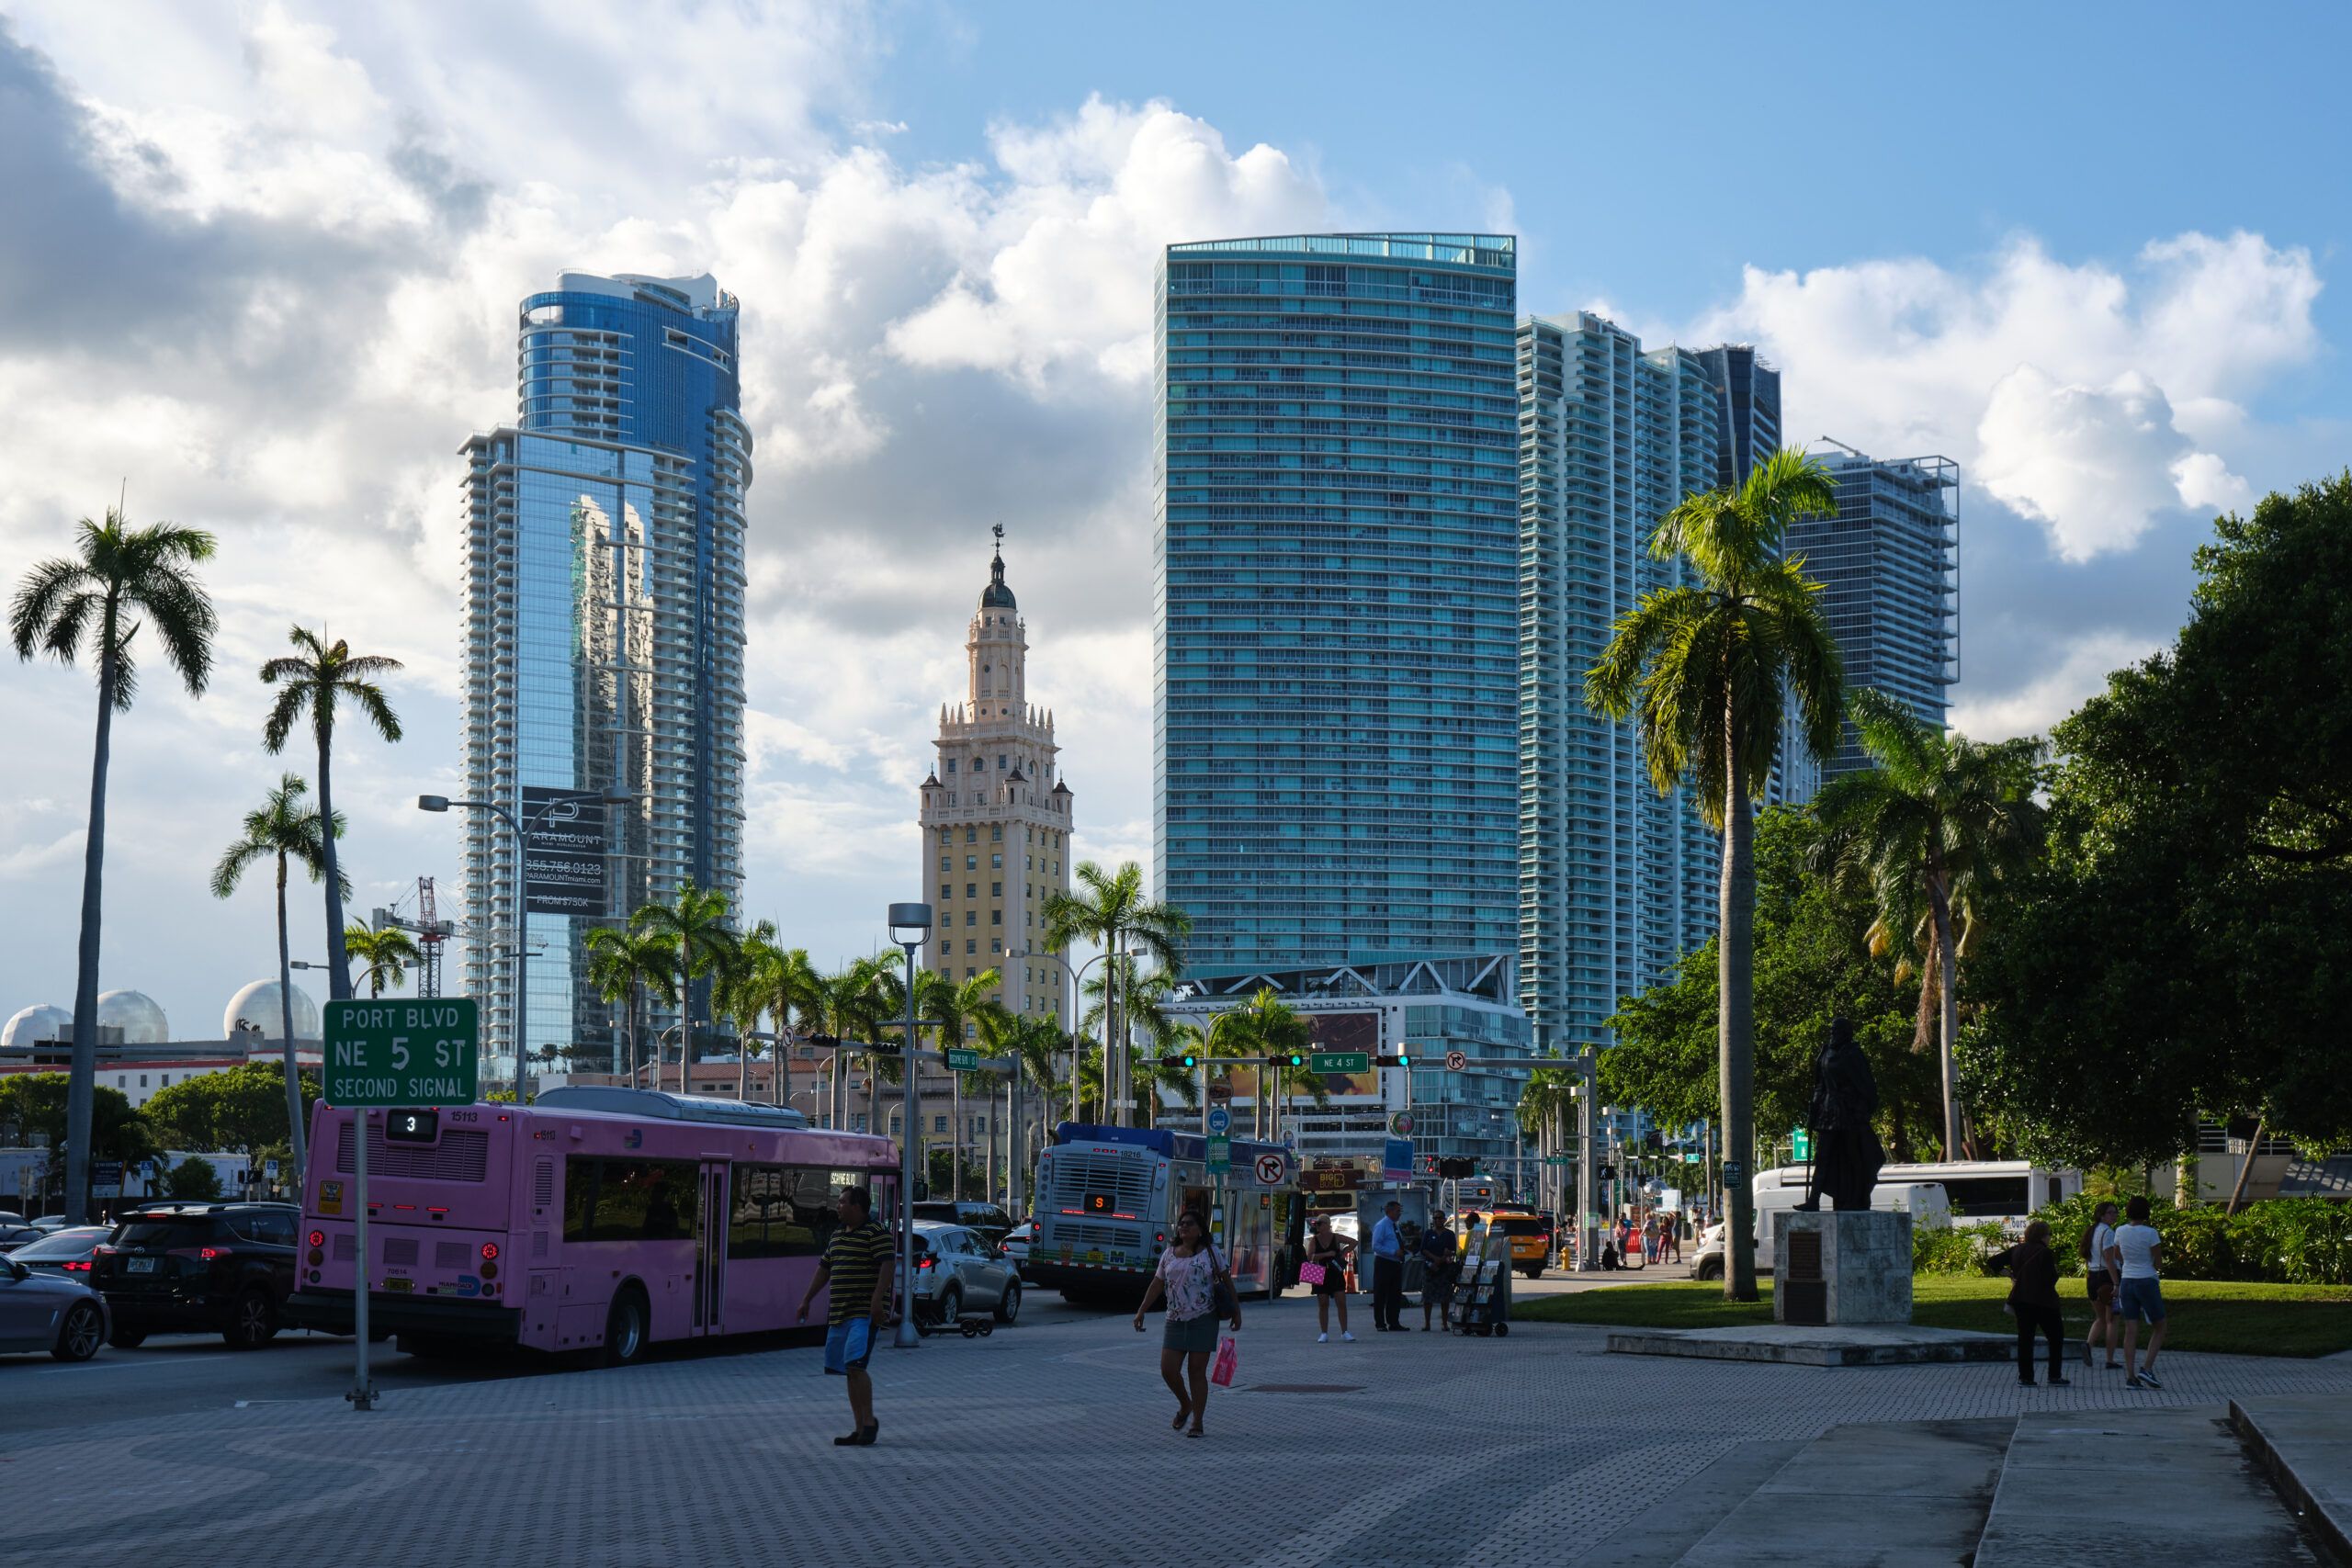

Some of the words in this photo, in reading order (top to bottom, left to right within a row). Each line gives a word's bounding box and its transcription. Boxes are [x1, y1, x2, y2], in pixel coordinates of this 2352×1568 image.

[532, 831, 601, 845] ARAMOUNT
[537, 895, 561, 905] FROM
[562, 897, 588, 907] $750K
[343, 1009, 396, 1029] PORT
[406, 1008, 458, 1029] BLVD
[335, 1041, 368, 1066] NE
[391, 1037, 410, 1070] 5
[435, 1039, 467, 1067] ST
[1324, 1058, 1334, 1067] NE
[1336, 1058, 1342, 1067] 4
[1345, 1058, 1354, 1067] ST
[334, 1078, 397, 1098] SECOND
[408, 1077, 467, 1098] SIGNAL
[451, 1111, 478, 1122] 15113
[407, 1117, 415, 1132] 3
[1120, 1150, 1141, 1158] 18216
[1095, 1196, 1103, 1208] S
